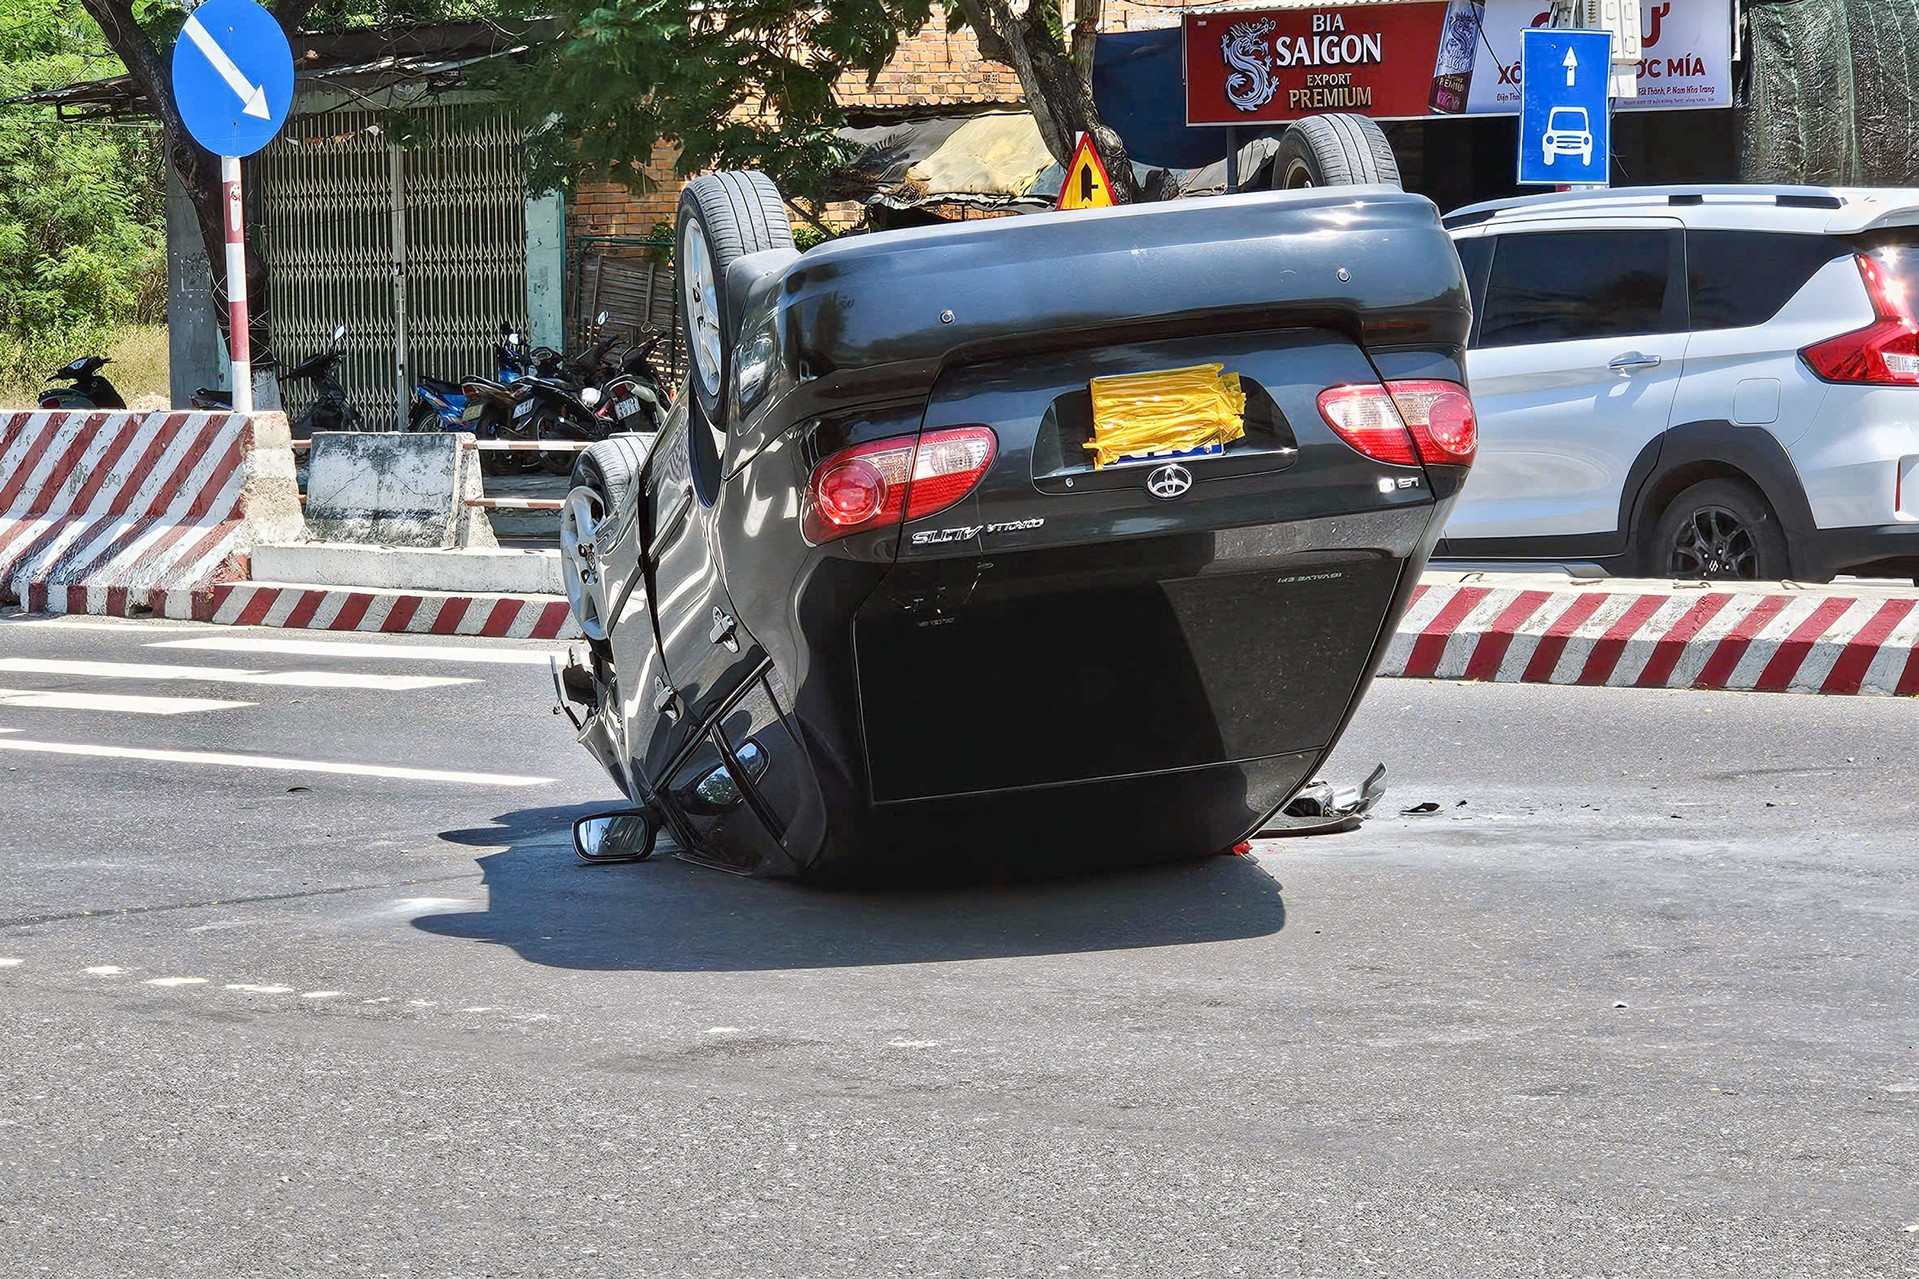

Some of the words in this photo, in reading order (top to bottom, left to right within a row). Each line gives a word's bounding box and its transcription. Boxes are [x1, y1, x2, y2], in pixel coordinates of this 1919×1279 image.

[1312, 13, 1345, 33] BIA
[1276, 33, 1382, 66] SAIGON
[1667, 52, 1706, 77] MÍA
[1306, 73, 1352, 86] EXPORT
[1289, 87, 1372, 109] PREMIUM
[911, 525, 984, 545] ALTIS
